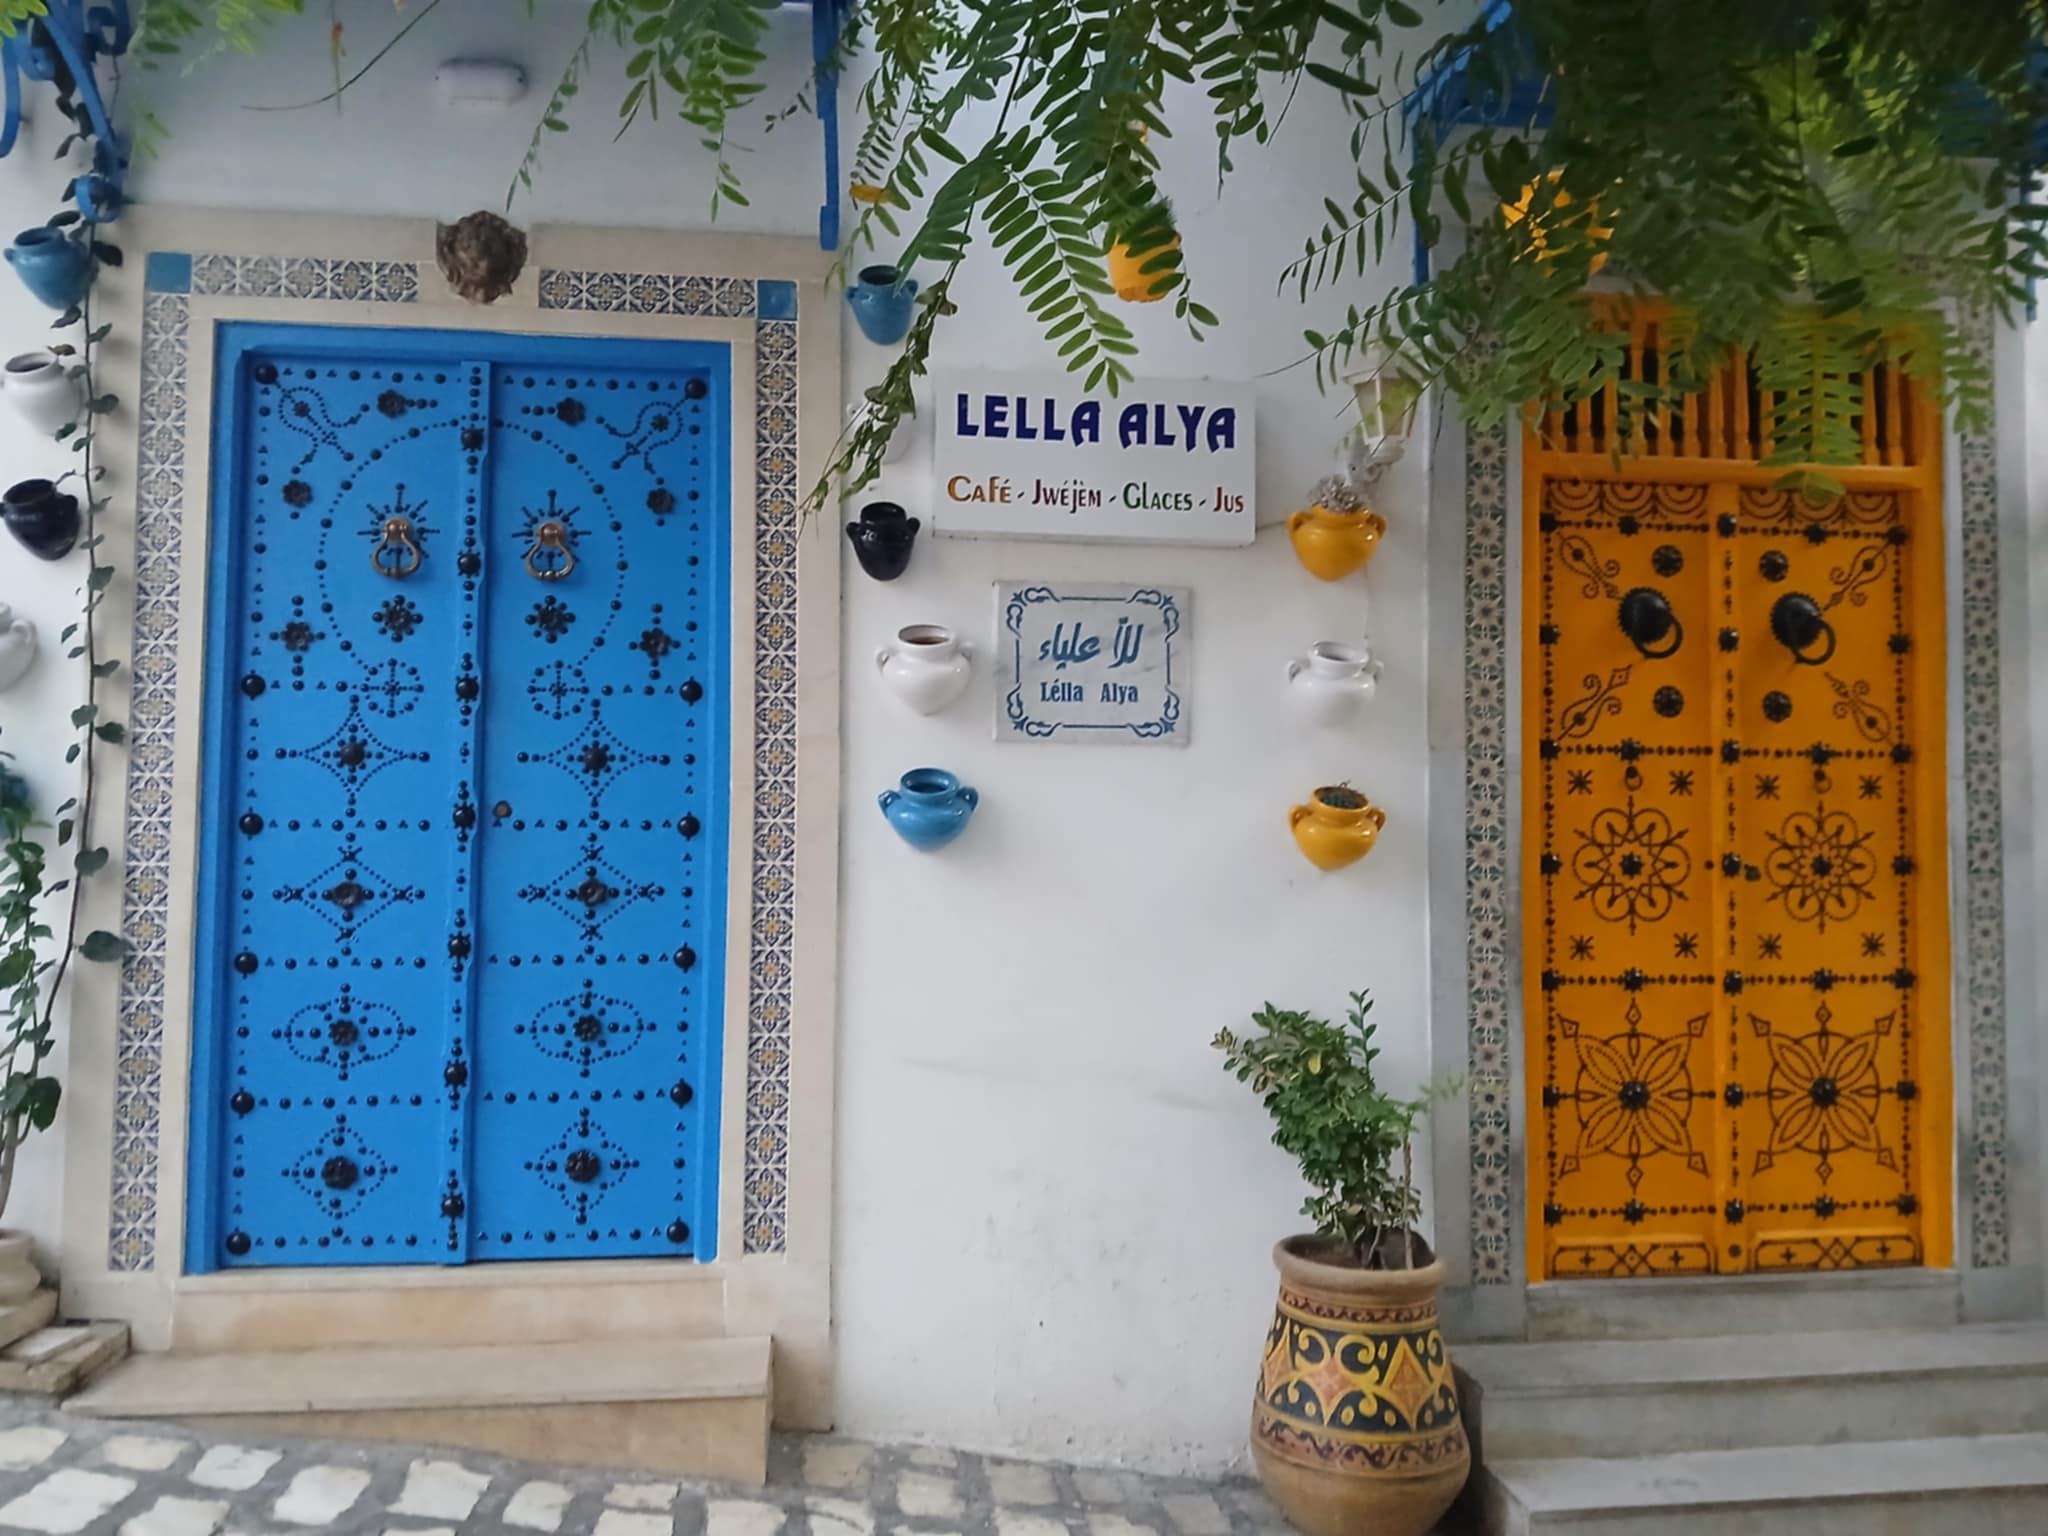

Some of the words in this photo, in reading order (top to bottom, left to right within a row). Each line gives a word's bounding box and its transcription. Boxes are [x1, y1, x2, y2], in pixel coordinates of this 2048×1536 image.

[957, 394, 1100, 446] LELLA
[1118, 403, 1236, 453] ALYA
[1213, 486, 1244, 513] Jus
[1038, 622, 1101, 671] علياء
[1040, 678, 1083, 702] Lélla
[1100, 683, 1139, 705] Alya
